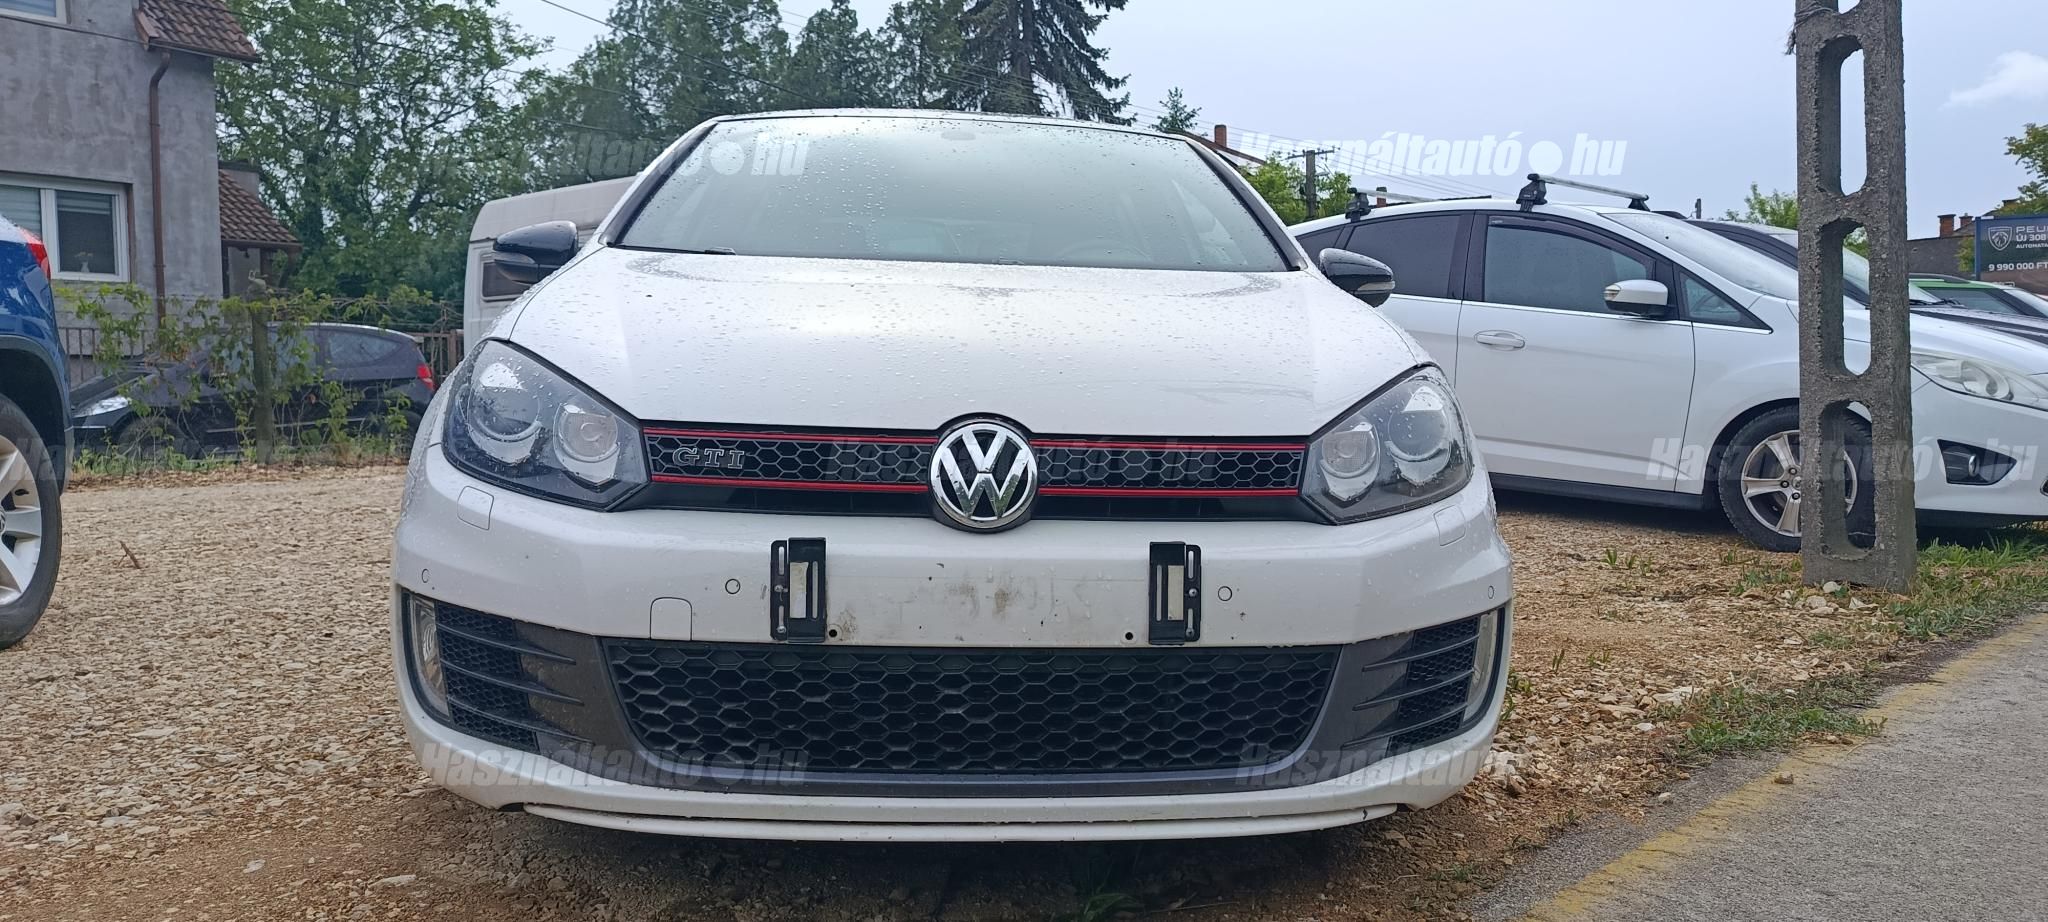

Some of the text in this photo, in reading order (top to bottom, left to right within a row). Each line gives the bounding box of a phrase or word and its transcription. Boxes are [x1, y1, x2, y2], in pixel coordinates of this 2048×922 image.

[2016, 225, 2048, 233] PEU
[2016, 262, 2035, 270] 000
[672, 446, 745, 470] GTI
